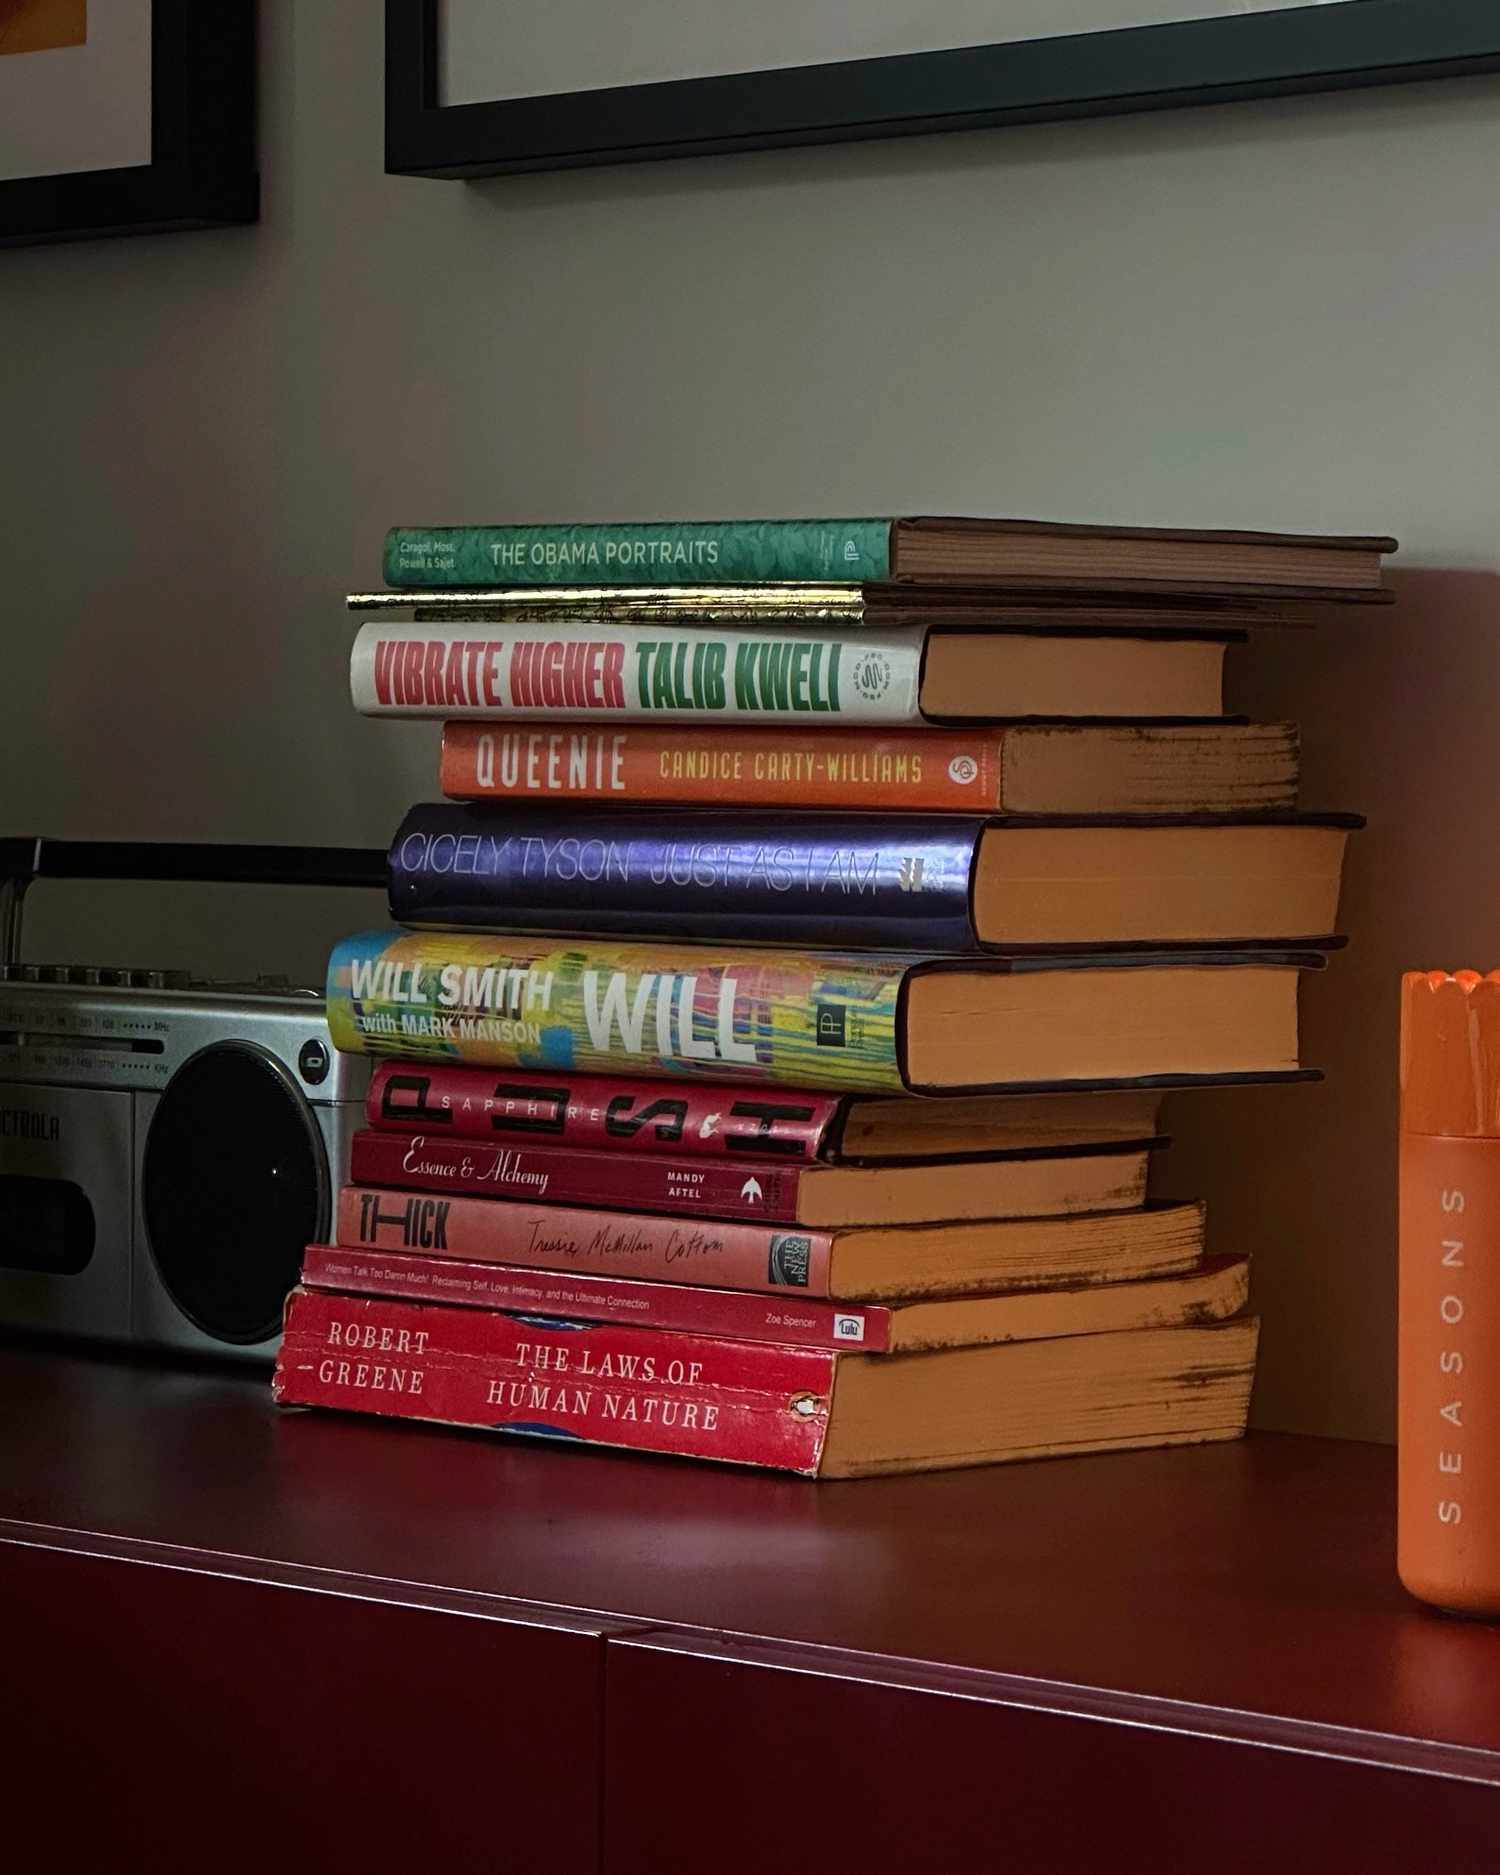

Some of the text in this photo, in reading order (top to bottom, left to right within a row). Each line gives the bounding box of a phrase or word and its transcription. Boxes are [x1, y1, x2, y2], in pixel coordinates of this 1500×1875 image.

[490, 541, 719, 566] THE OBAMA PORTRAITS
[374, 641, 503, 706] VIBRATE
[510, 641, 627, 709] HIGHER
[635, 642, 728, 710] TALIB
[733, 643, 841, 712] KWELI
[475, 733, 627, 791] QUEENIE
[659, 750, 922, 784] CANDICE CARTY-WILLIAMS
[400, 831, 513, 873] CICELY
[519, 836, 630, 884] TYSON
[650, 843, 738, 888] JUST
[746, 846, 797, 891] AS
[804, 849, 815, 892] I
[817, 849, 880, 895] AM
[350, 958, 554, 1012] WILL SMITH
[361, 1013, 541, 1044] with MARK MANSON
[583, 970, 756, 1062] WILL
[0, 1110, 60, 1141] CTROLA
[441, 1095, 600, 1122] SAPPHIRE
[402, 1136, 550, 1195] Essence & Alchemy
[667, 1171, 706, 1183] MANDY
[668, 1187, 702, 1199] AFTEL
[360, 1194, 450, 1250] THICK
[353, 1265, 369, 1277] Talk
[370, 1267, 384, 1278] Too
[545, 1288, 562, 1299] and
[562, 1291, 574, 1302] the
[575, 1293, 606, 1306] Ultimate
[607, 1295, 650, 1310] Connection
[328, 1322, 429, 1354] ROBERT
[783, 1314, 817, 1329] Spencer
[516, 1344, 703, 1385] THE LAWS OF
[1438, 1188, 1466, 1525] SEASONS
[318, 1361, 424, 1395] GREENE
[487, 1381, 719, 1432] HUMAN NATURE
